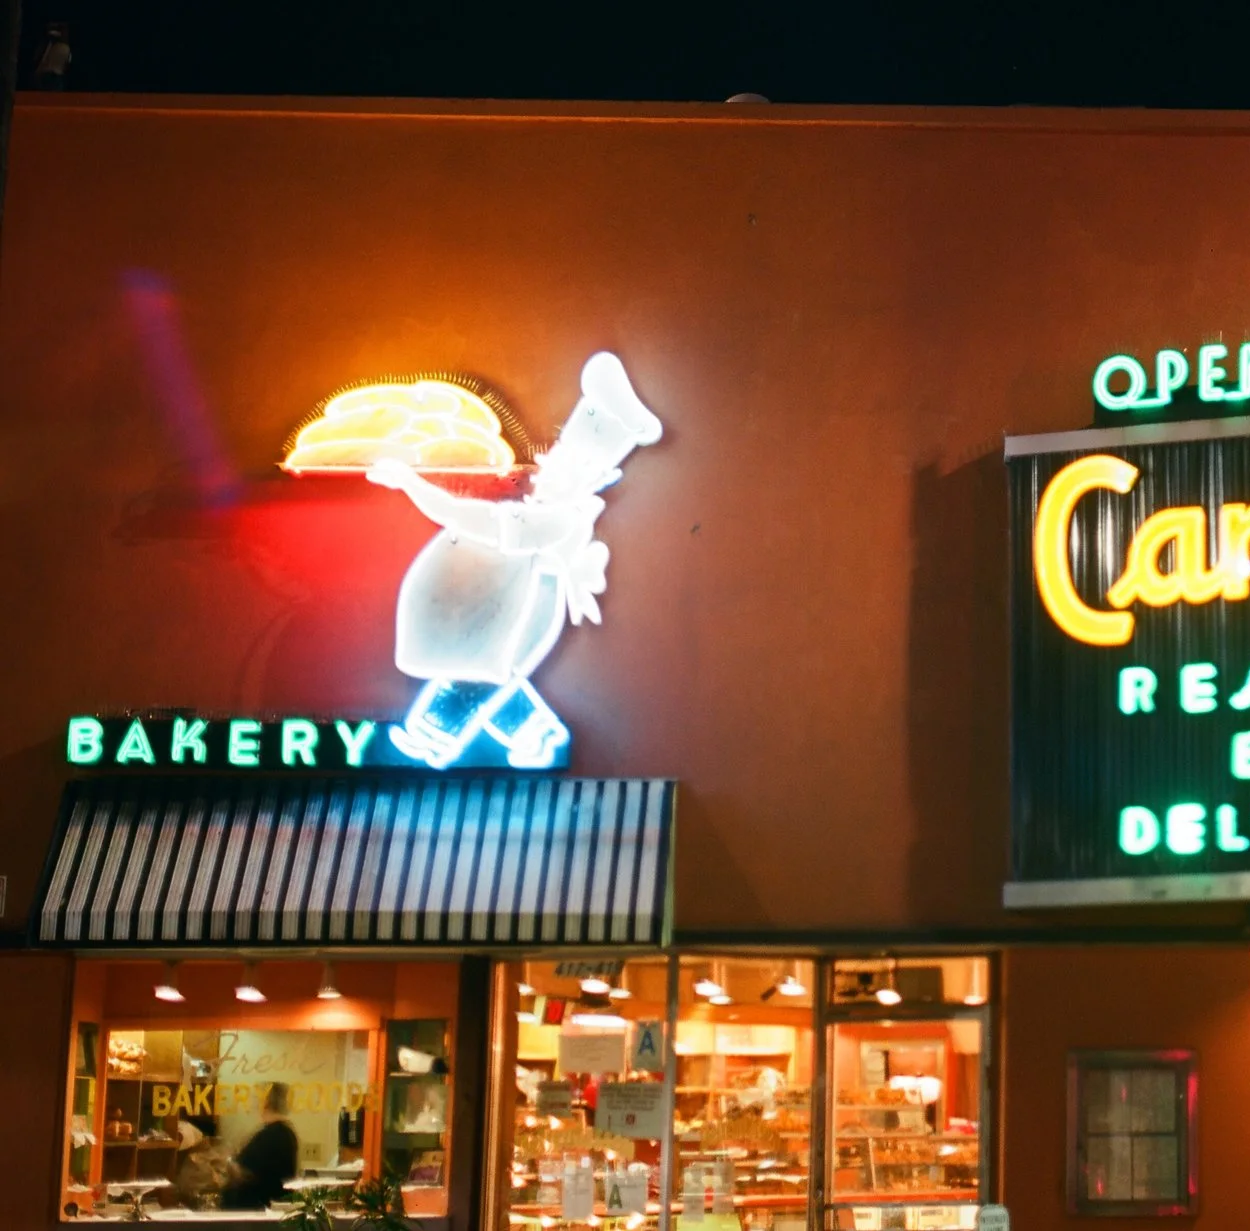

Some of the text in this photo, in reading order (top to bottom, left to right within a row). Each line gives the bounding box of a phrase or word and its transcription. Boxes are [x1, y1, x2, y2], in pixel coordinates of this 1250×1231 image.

[67, 716, 377, 767] BAKERY
[194, 1031, 327, 1076] Fresh
[637, 1029, 657, 1056] A
[152, 1079, 382, 1118] BAKERY GOODS
[608, 1183, 623, 1210] A
